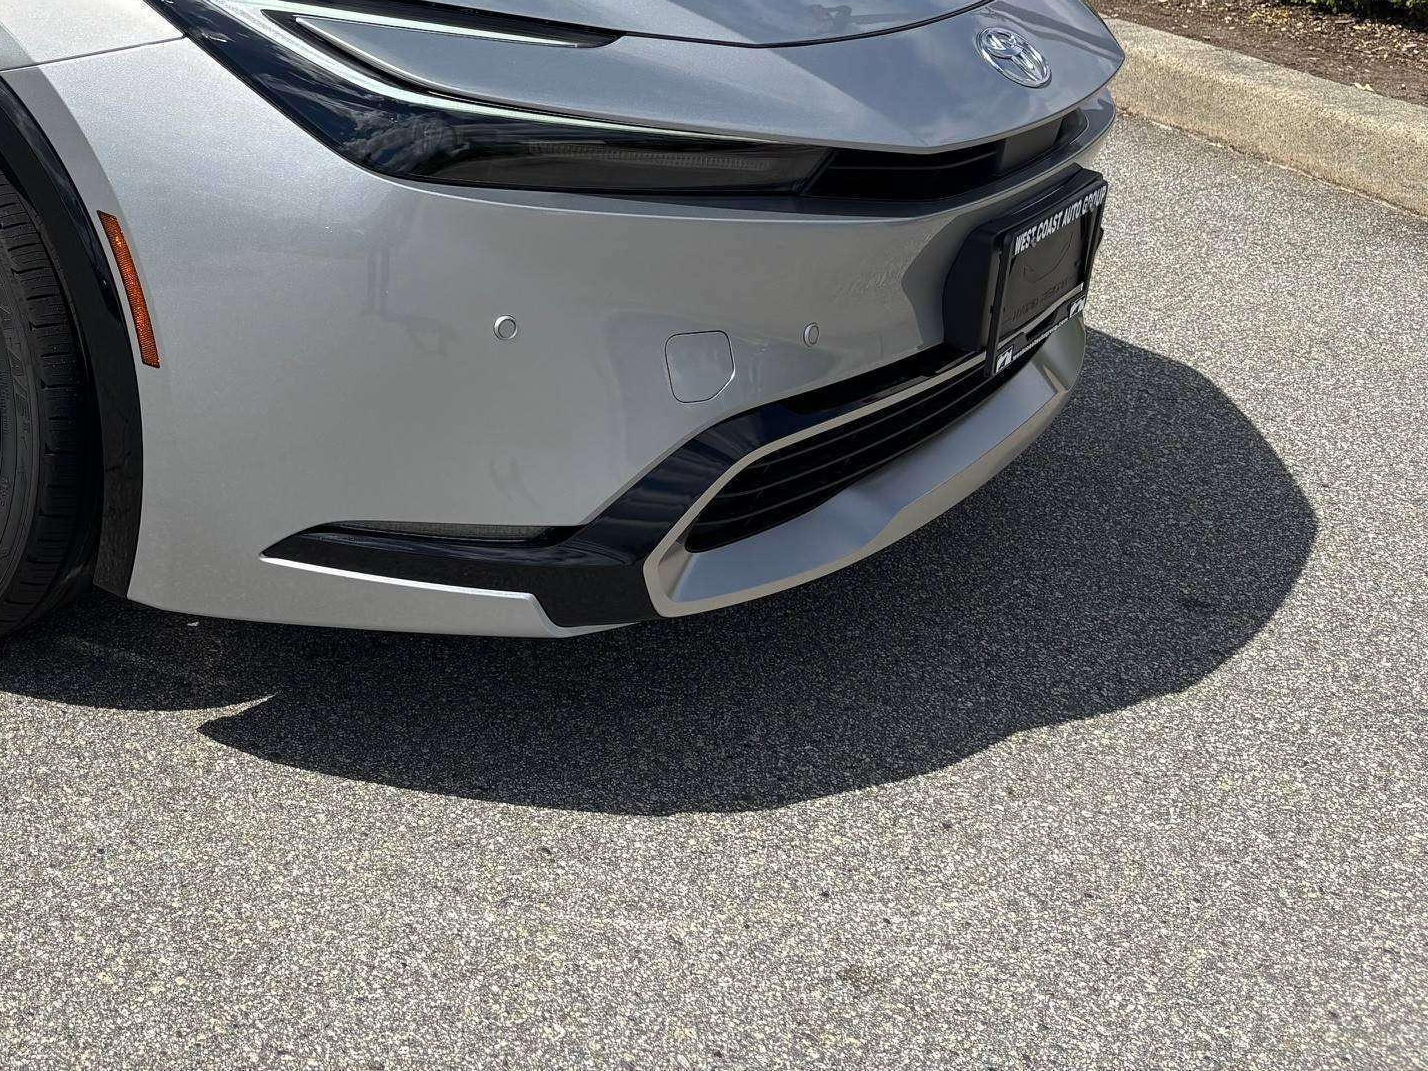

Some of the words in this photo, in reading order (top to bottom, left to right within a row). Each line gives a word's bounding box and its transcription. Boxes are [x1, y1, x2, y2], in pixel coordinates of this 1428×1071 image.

[1014, 226, 1038, 256] WEST
[1036, 211, 1064, 242] COAST
[1062, 199, 1083, 228] AUTO
